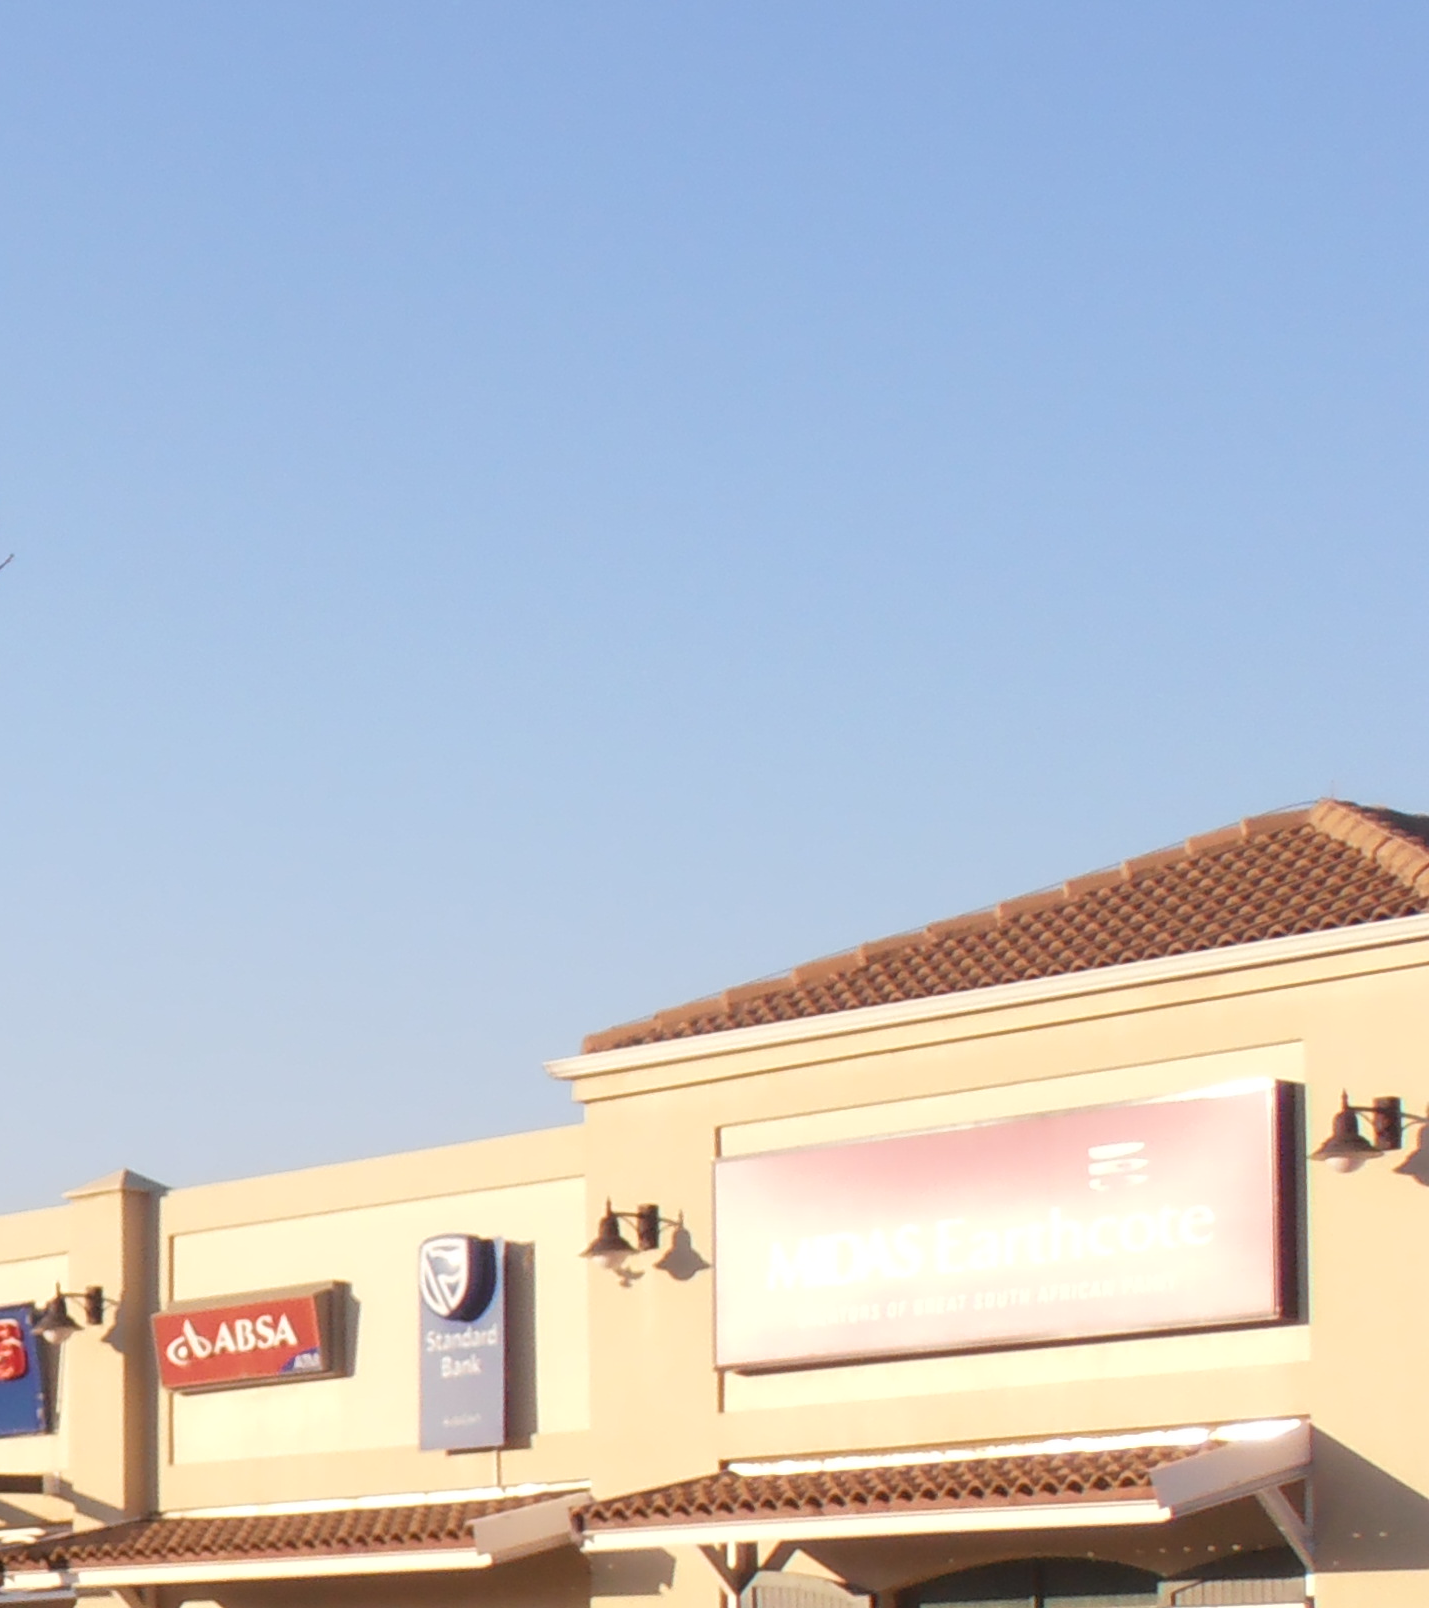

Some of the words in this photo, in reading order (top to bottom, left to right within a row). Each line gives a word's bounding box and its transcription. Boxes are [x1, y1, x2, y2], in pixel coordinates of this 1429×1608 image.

[765, 1224, 922, 1291] MIDAS
[935, 1205, 1215, 1274] Earthcote
[214, 1312, 299, 1355] ABSA
[425, 1322, 499, 1352] Standard
[441, 1353, 482, 1378] Bank
